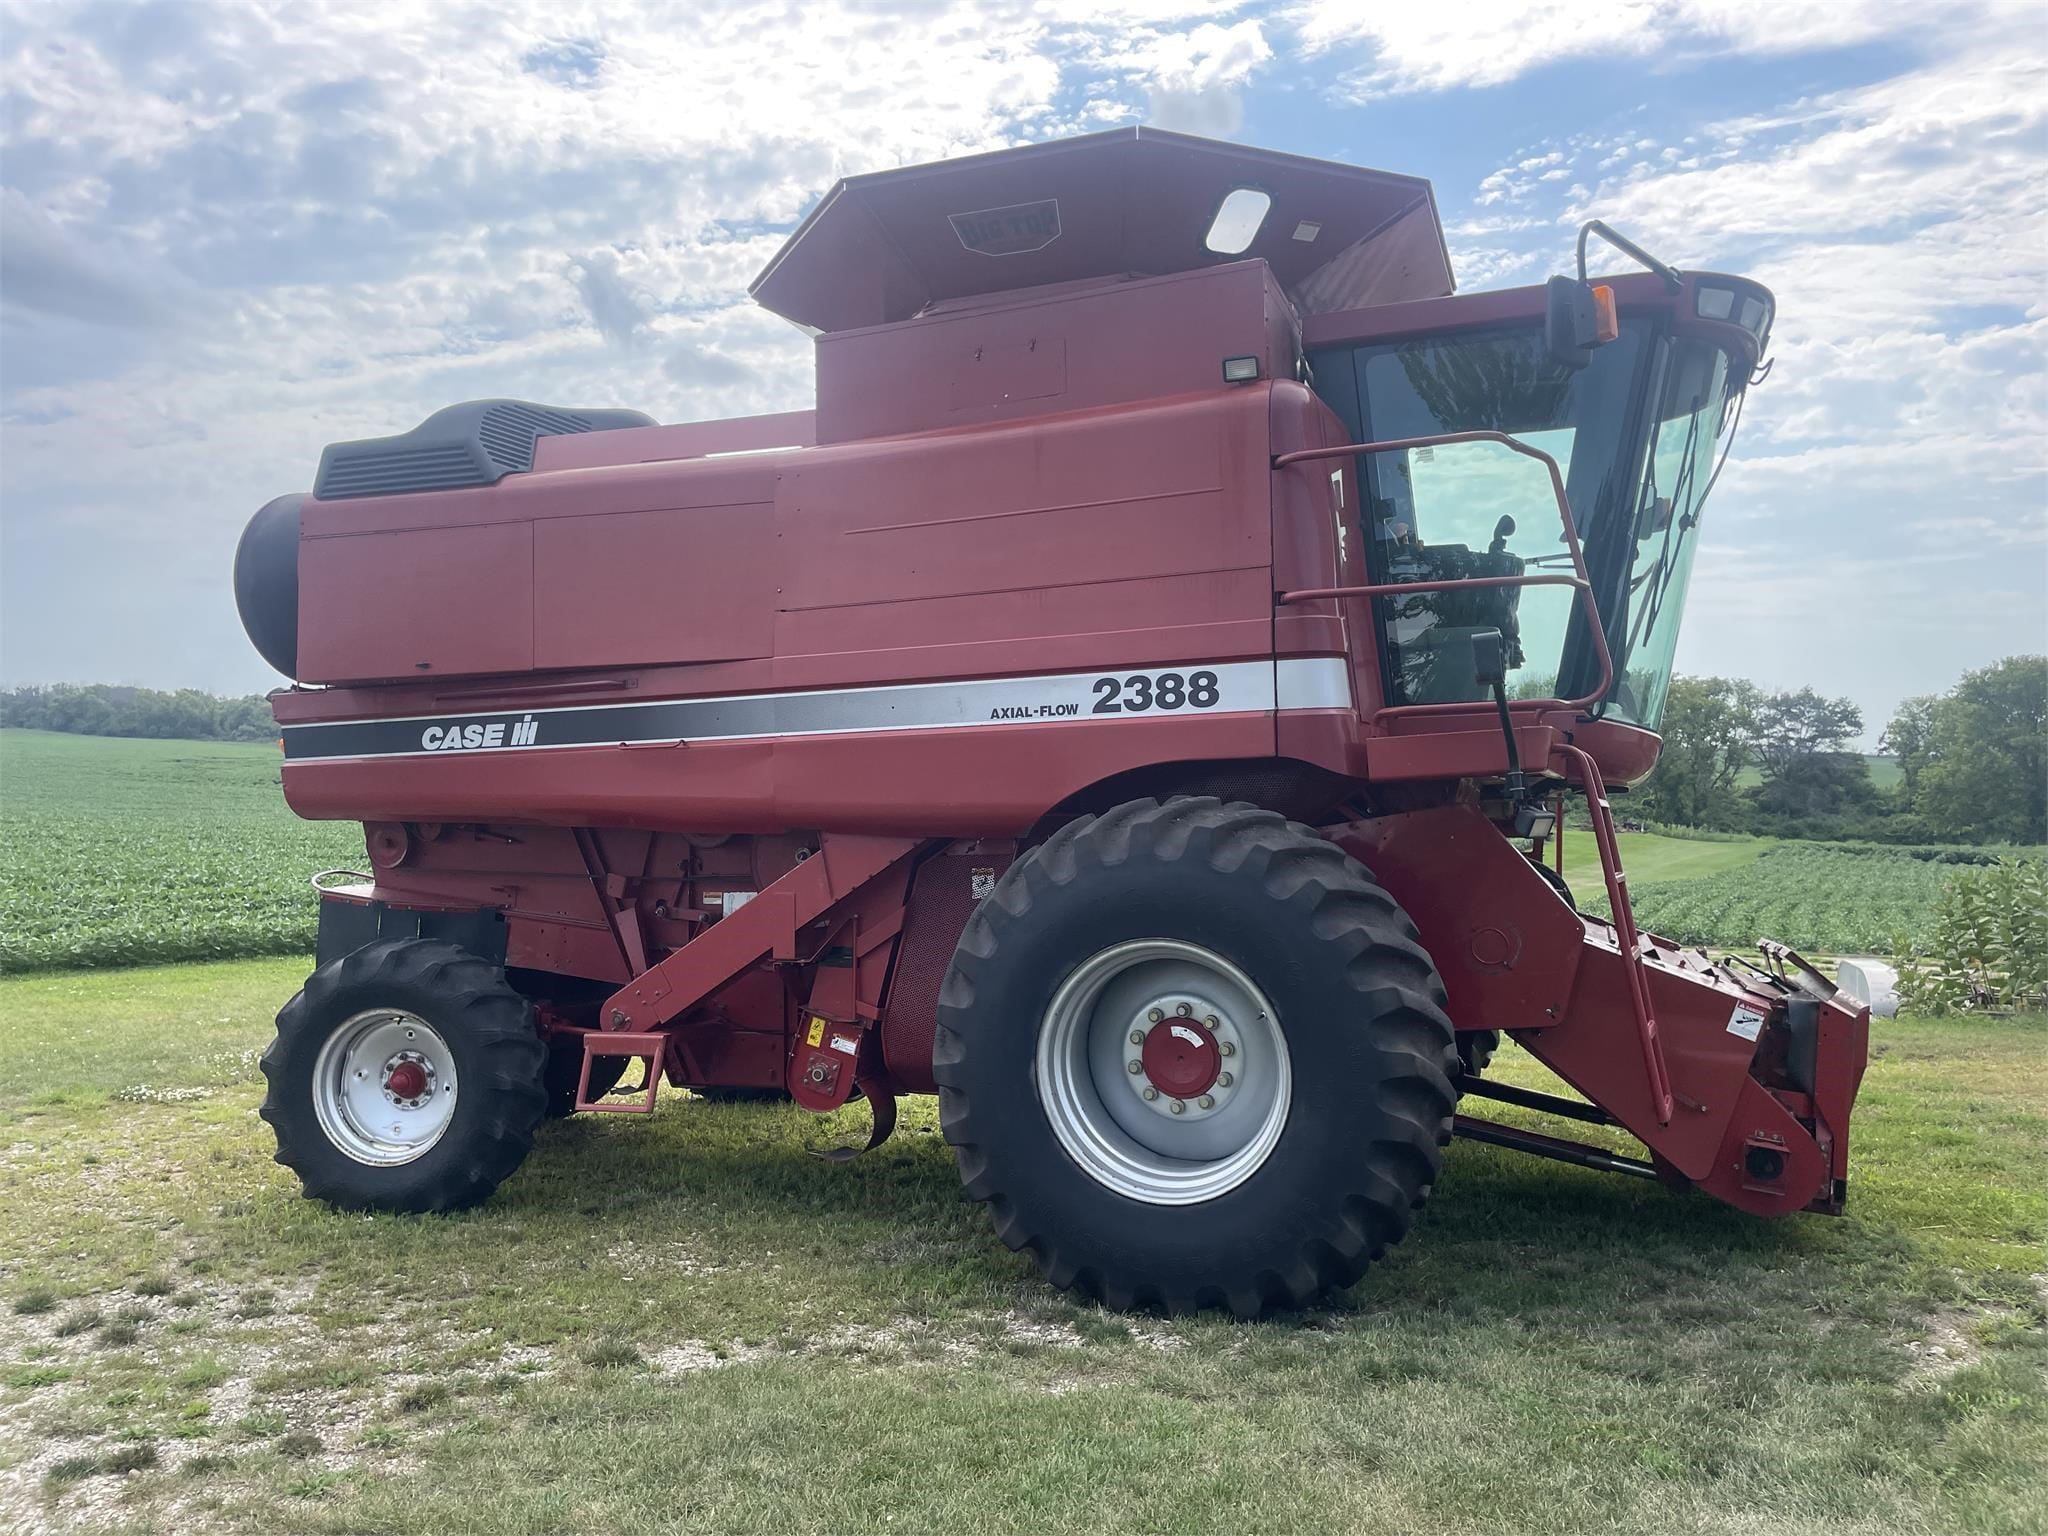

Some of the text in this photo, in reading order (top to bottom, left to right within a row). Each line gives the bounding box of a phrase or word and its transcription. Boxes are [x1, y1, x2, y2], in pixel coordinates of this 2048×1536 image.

[990, 671, 1220, 719] AXIAL-FLOW 2388
[421, 723, 505, 750] CASE
